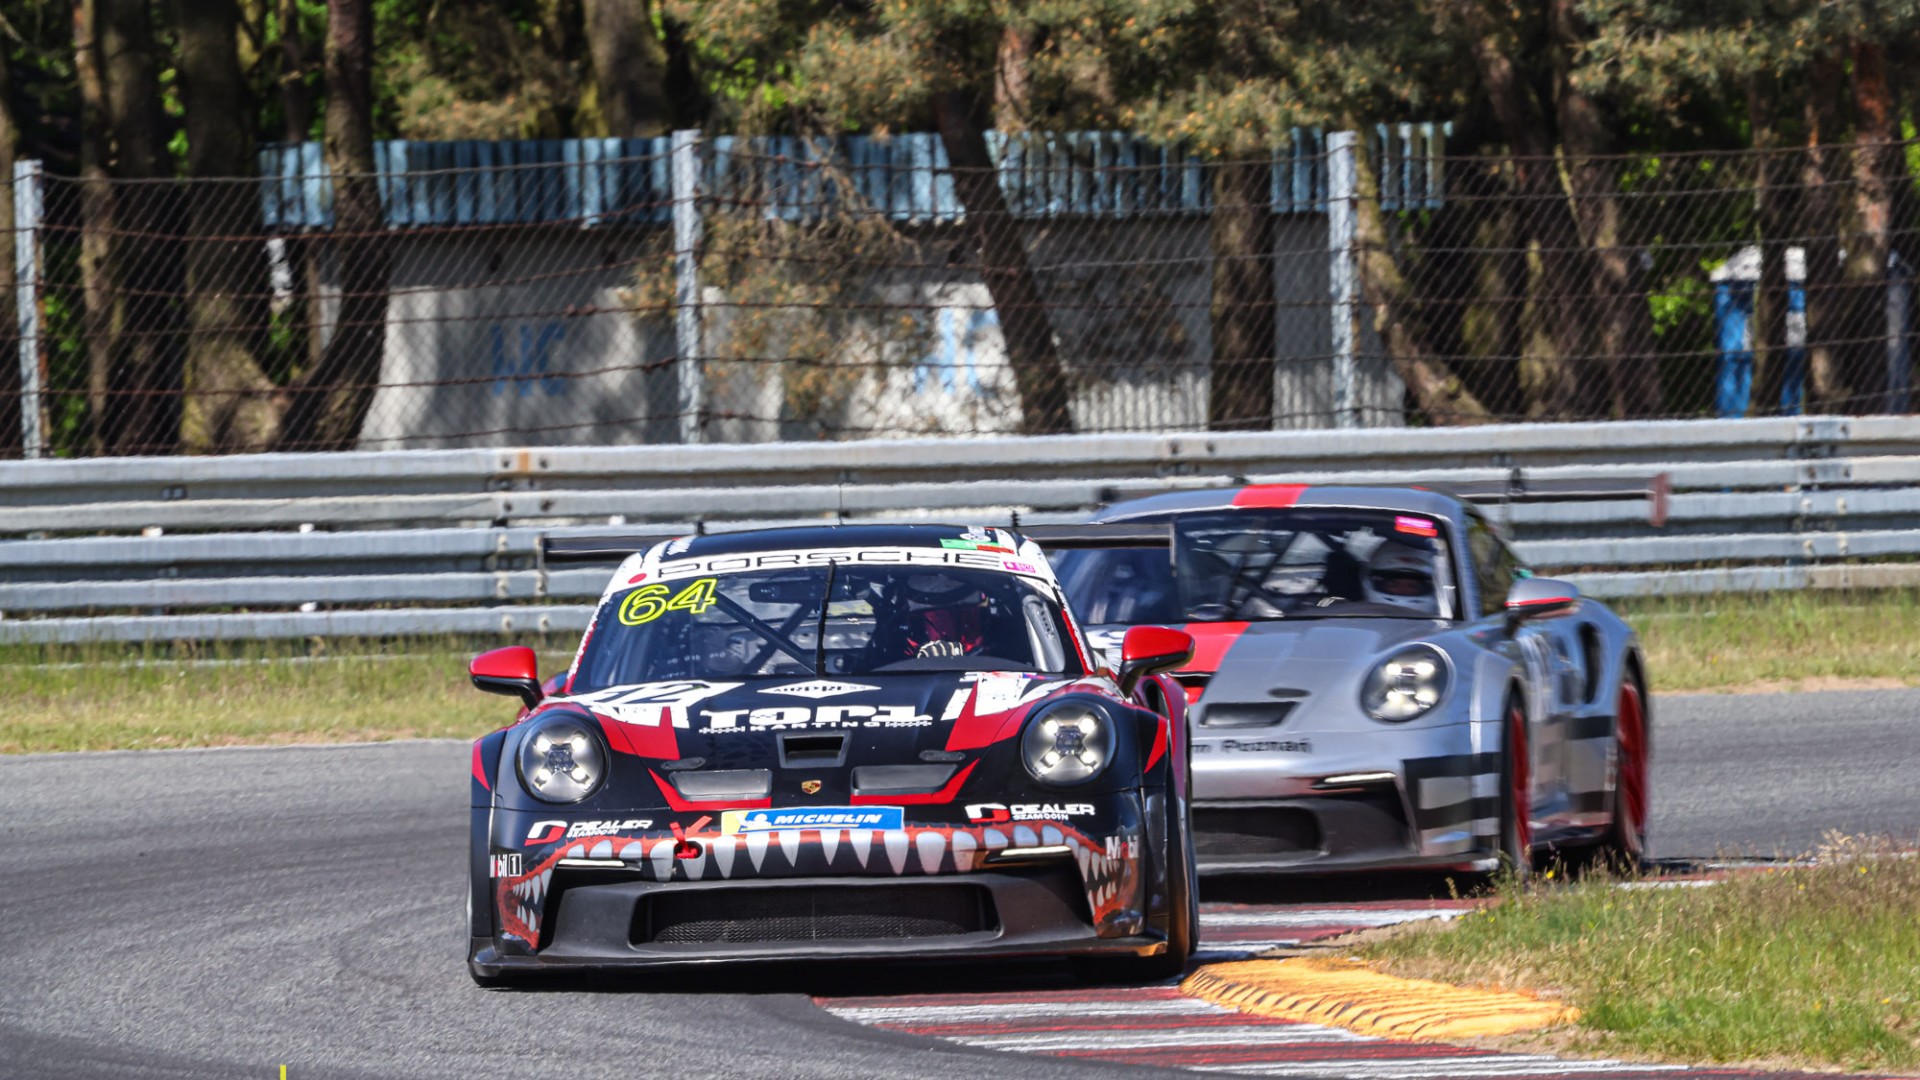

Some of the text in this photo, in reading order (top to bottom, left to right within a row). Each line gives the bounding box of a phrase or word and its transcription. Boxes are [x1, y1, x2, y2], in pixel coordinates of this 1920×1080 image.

[490, 323, 567, 397] WC
[658, 550, 1000, 578] PORSCHE
[619, 578, 717, 626] 64
[751, 720, 881, 732] KARTING
[1010, 803, 1096, 816] DEALER
[570, 819, 653, 830] DEALER
[774, 813, 883, 825] MICHELIN
[490, 854, 508, 878] Mobil
